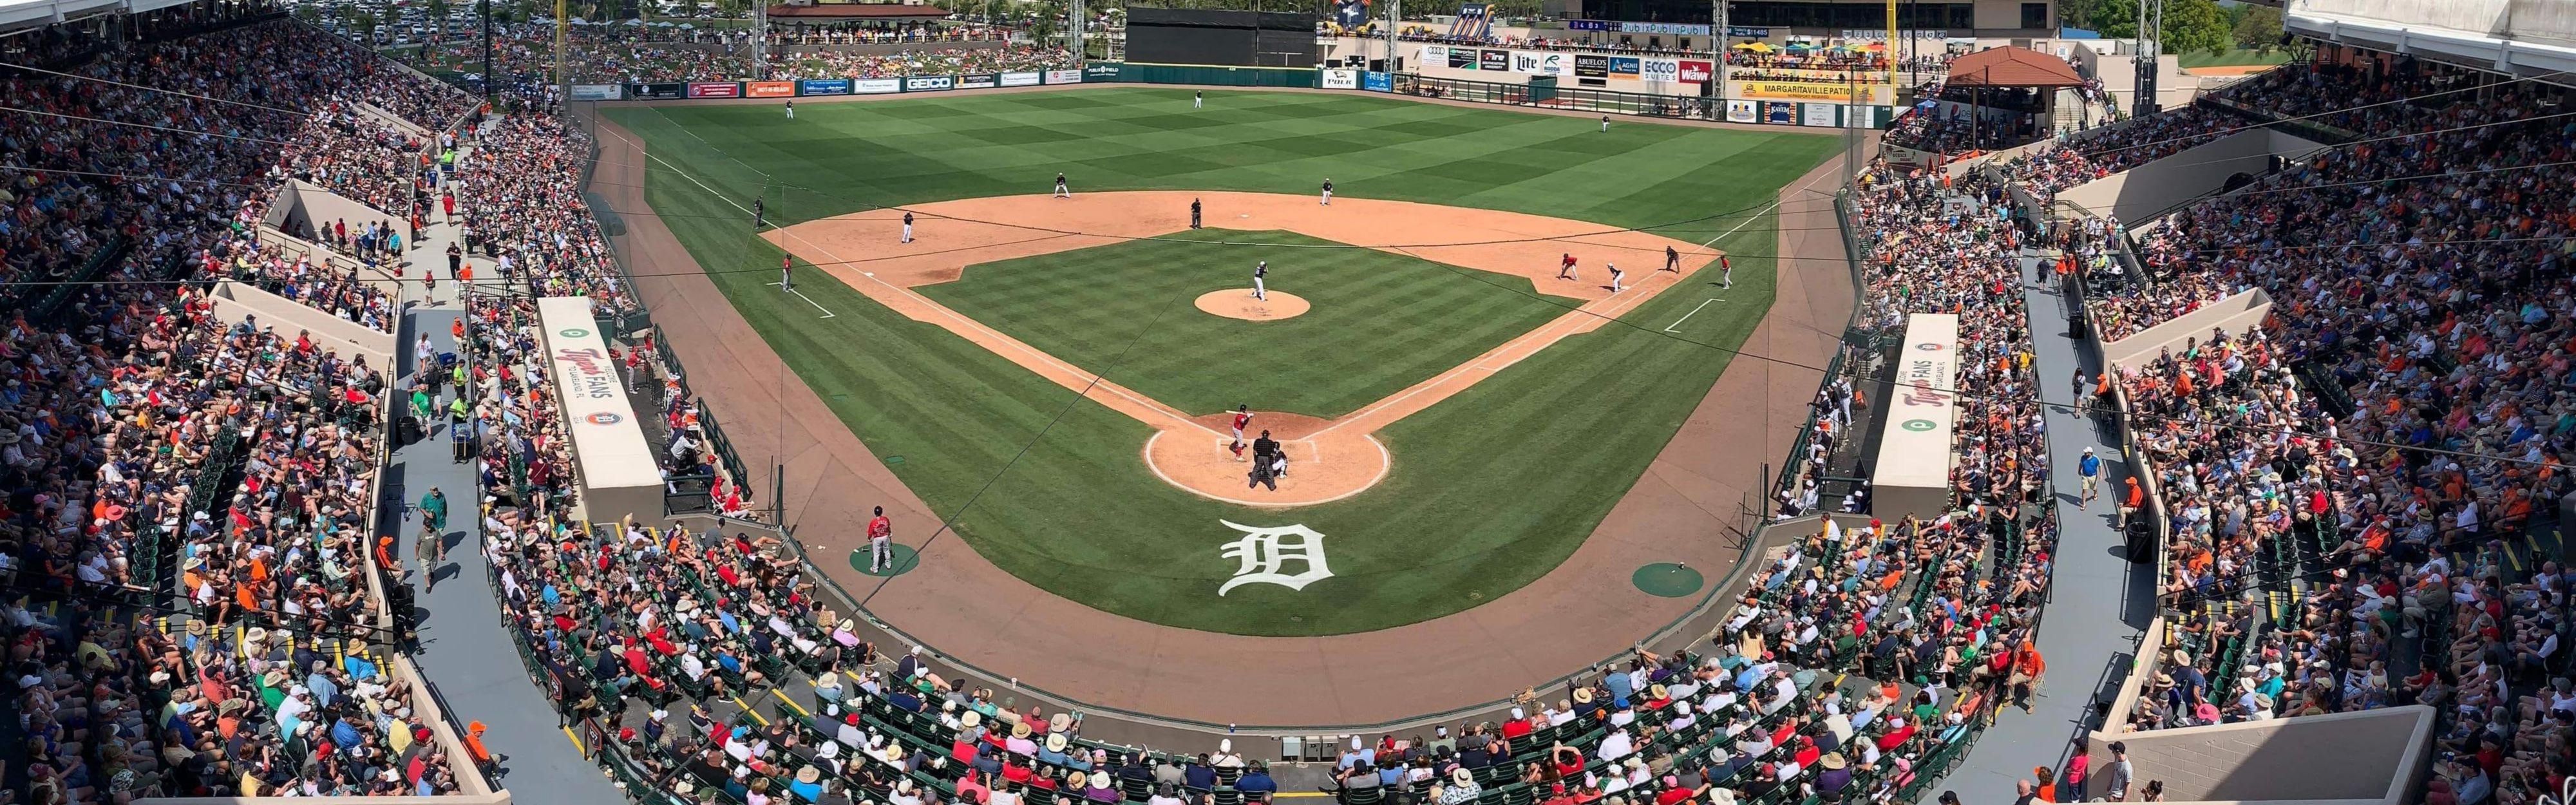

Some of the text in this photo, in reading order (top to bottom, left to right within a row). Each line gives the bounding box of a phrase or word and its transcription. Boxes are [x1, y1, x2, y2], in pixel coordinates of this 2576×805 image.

[1517, 55, 1537, 71] Lite
[1645, 61, 1676, 74] ECCO
[1681, 68, 1709, 81] Waw
[908, 77, 950, 90] GEICO
[1765, 85, 1850, 95] MARGARITAVILLE PATIO
[1771, 106, 1790, 115] KAYEM
[554, 348, 612, 399] Tigers FANS
[1911, 360, 1933, 378] FANS
